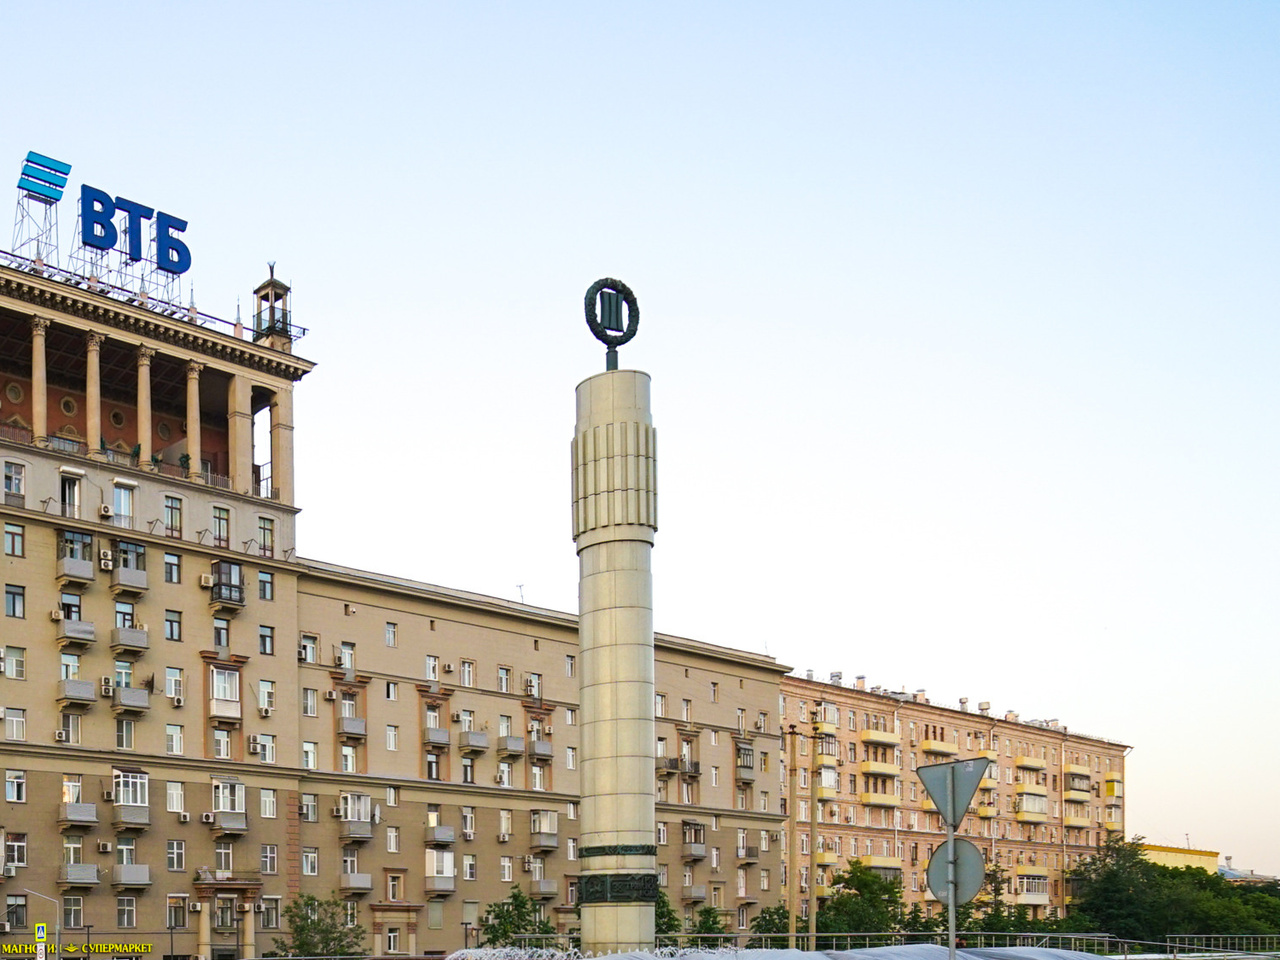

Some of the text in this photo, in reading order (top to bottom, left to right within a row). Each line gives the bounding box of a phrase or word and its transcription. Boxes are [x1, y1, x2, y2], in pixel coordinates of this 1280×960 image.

[81, 184, 191, 274] ВТБ
[2, 943, 153, 953] МАГНОИ СУПЕРМАРКЕТ
